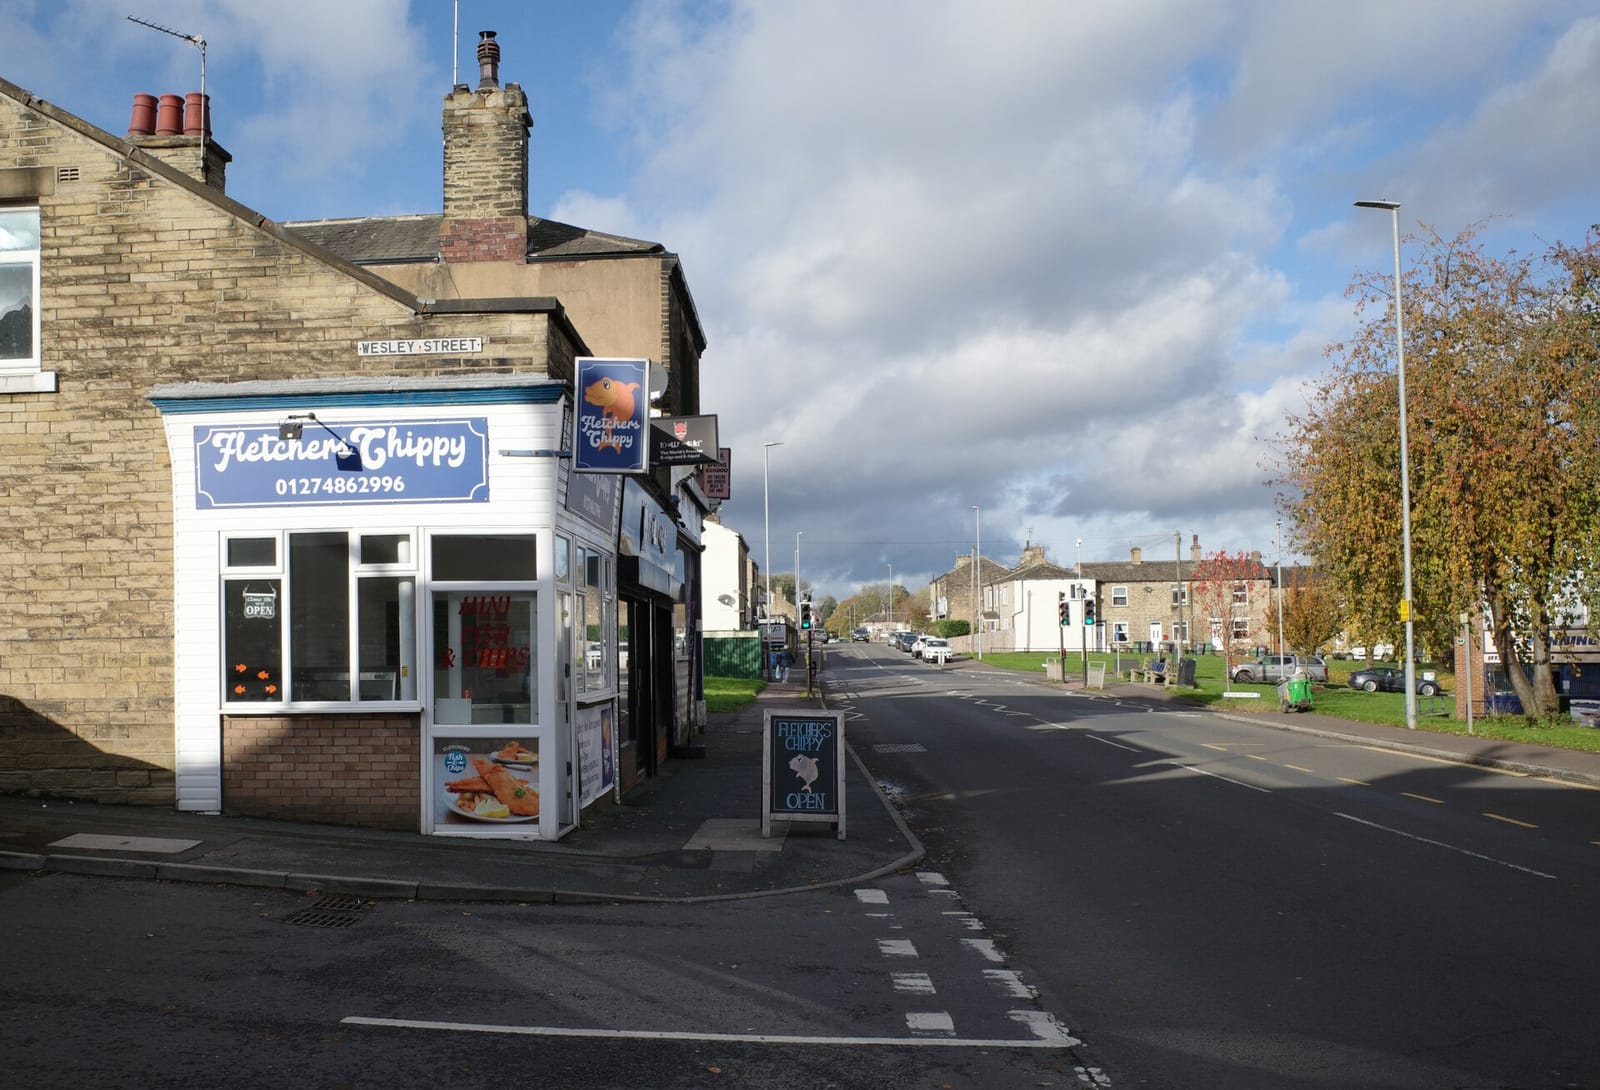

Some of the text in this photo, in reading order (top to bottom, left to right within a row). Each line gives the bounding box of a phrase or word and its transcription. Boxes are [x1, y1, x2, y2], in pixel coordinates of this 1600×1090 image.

[361, 338, 477, 354] WESLEY STREET
[581, 415, 641, 433] Fletchers
[585, 429, 633, 448] Chippy
[212, 426, 466, 472] Fletchers Chippy
[275, 476, 406, 495] 01274862996
[246, 605, 273, 615] OPEN
[458, 595, 512, 615] MINI
[441, 647, 456, 668] &
[778, 722, 832, 738] FLETCHERS
[785, 736, 825, 752] CHIPPY
[786, 793, 826, 809] OPEN
